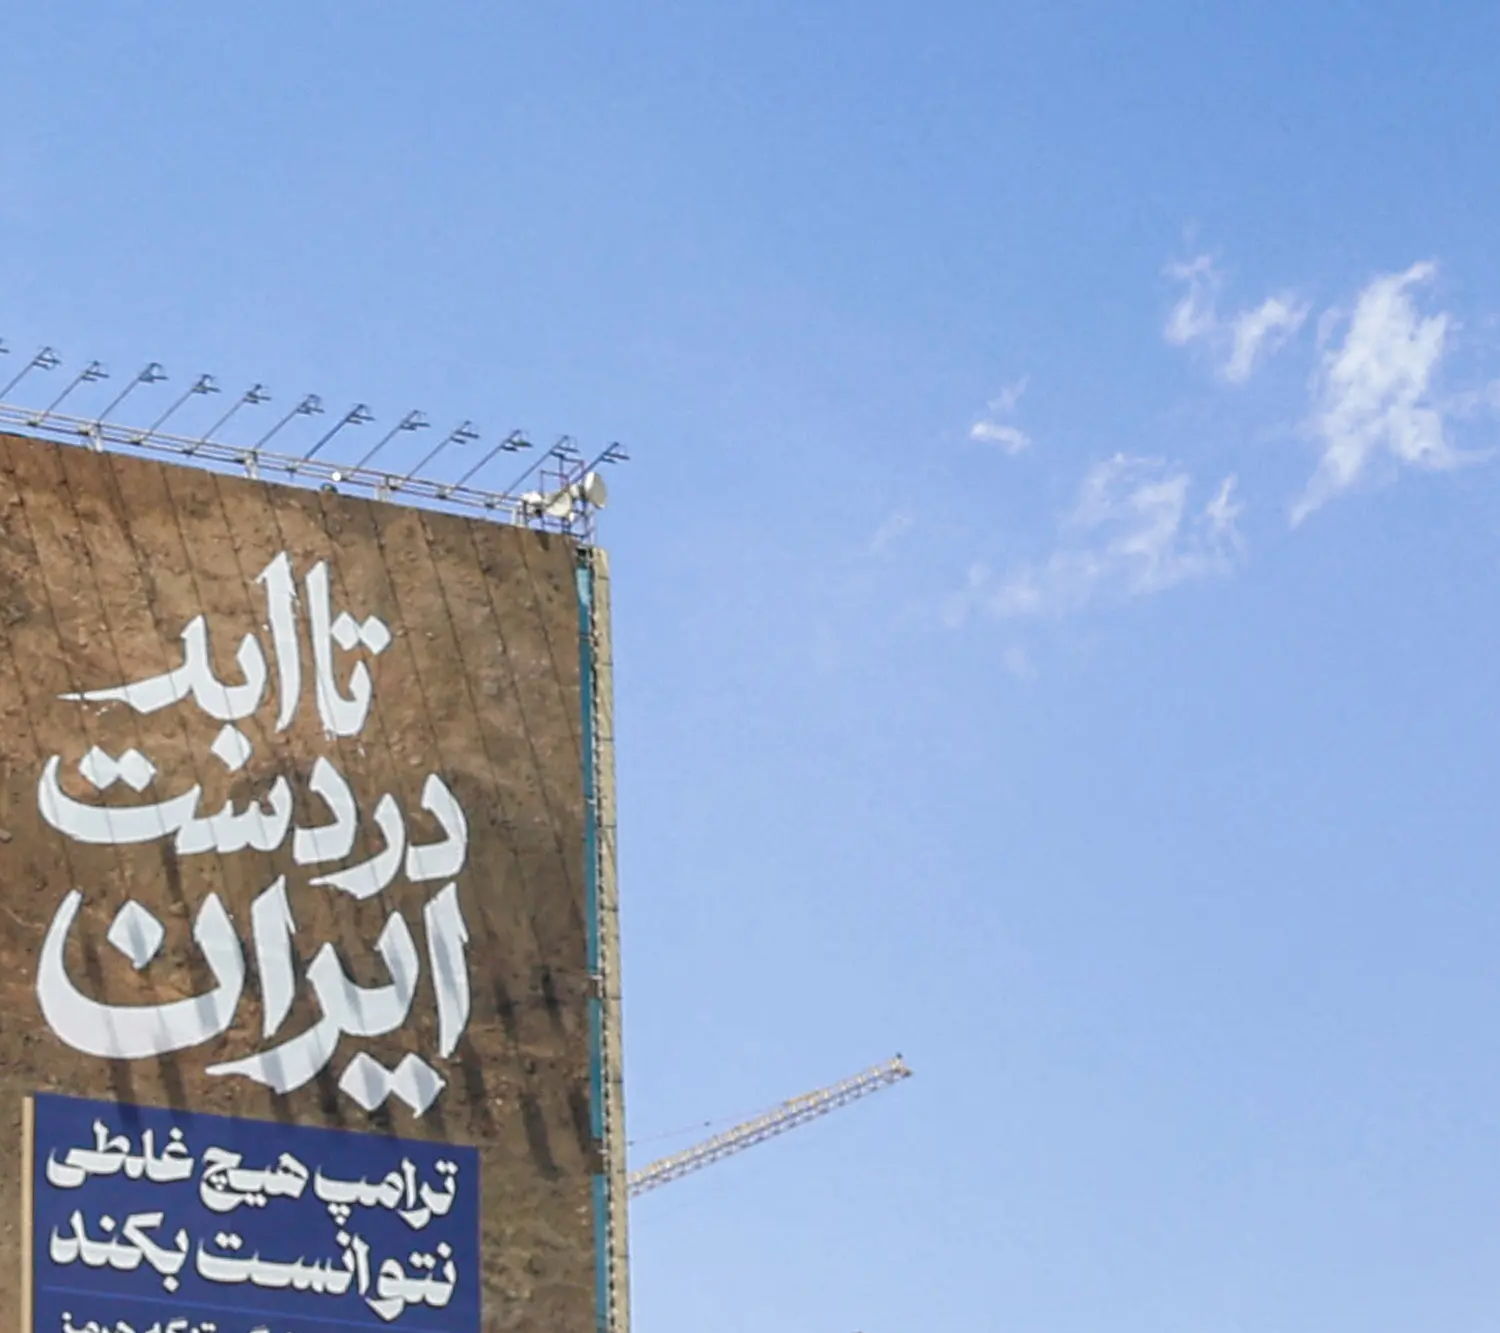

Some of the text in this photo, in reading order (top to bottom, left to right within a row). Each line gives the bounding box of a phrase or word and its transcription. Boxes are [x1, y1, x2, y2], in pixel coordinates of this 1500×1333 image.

[36, 874, 471, 1118] ایران
[46, 1119, 458, 1229] ترامپ هیچ غلطی
[49, 1209, 458, 1320] نتوانست بکند
